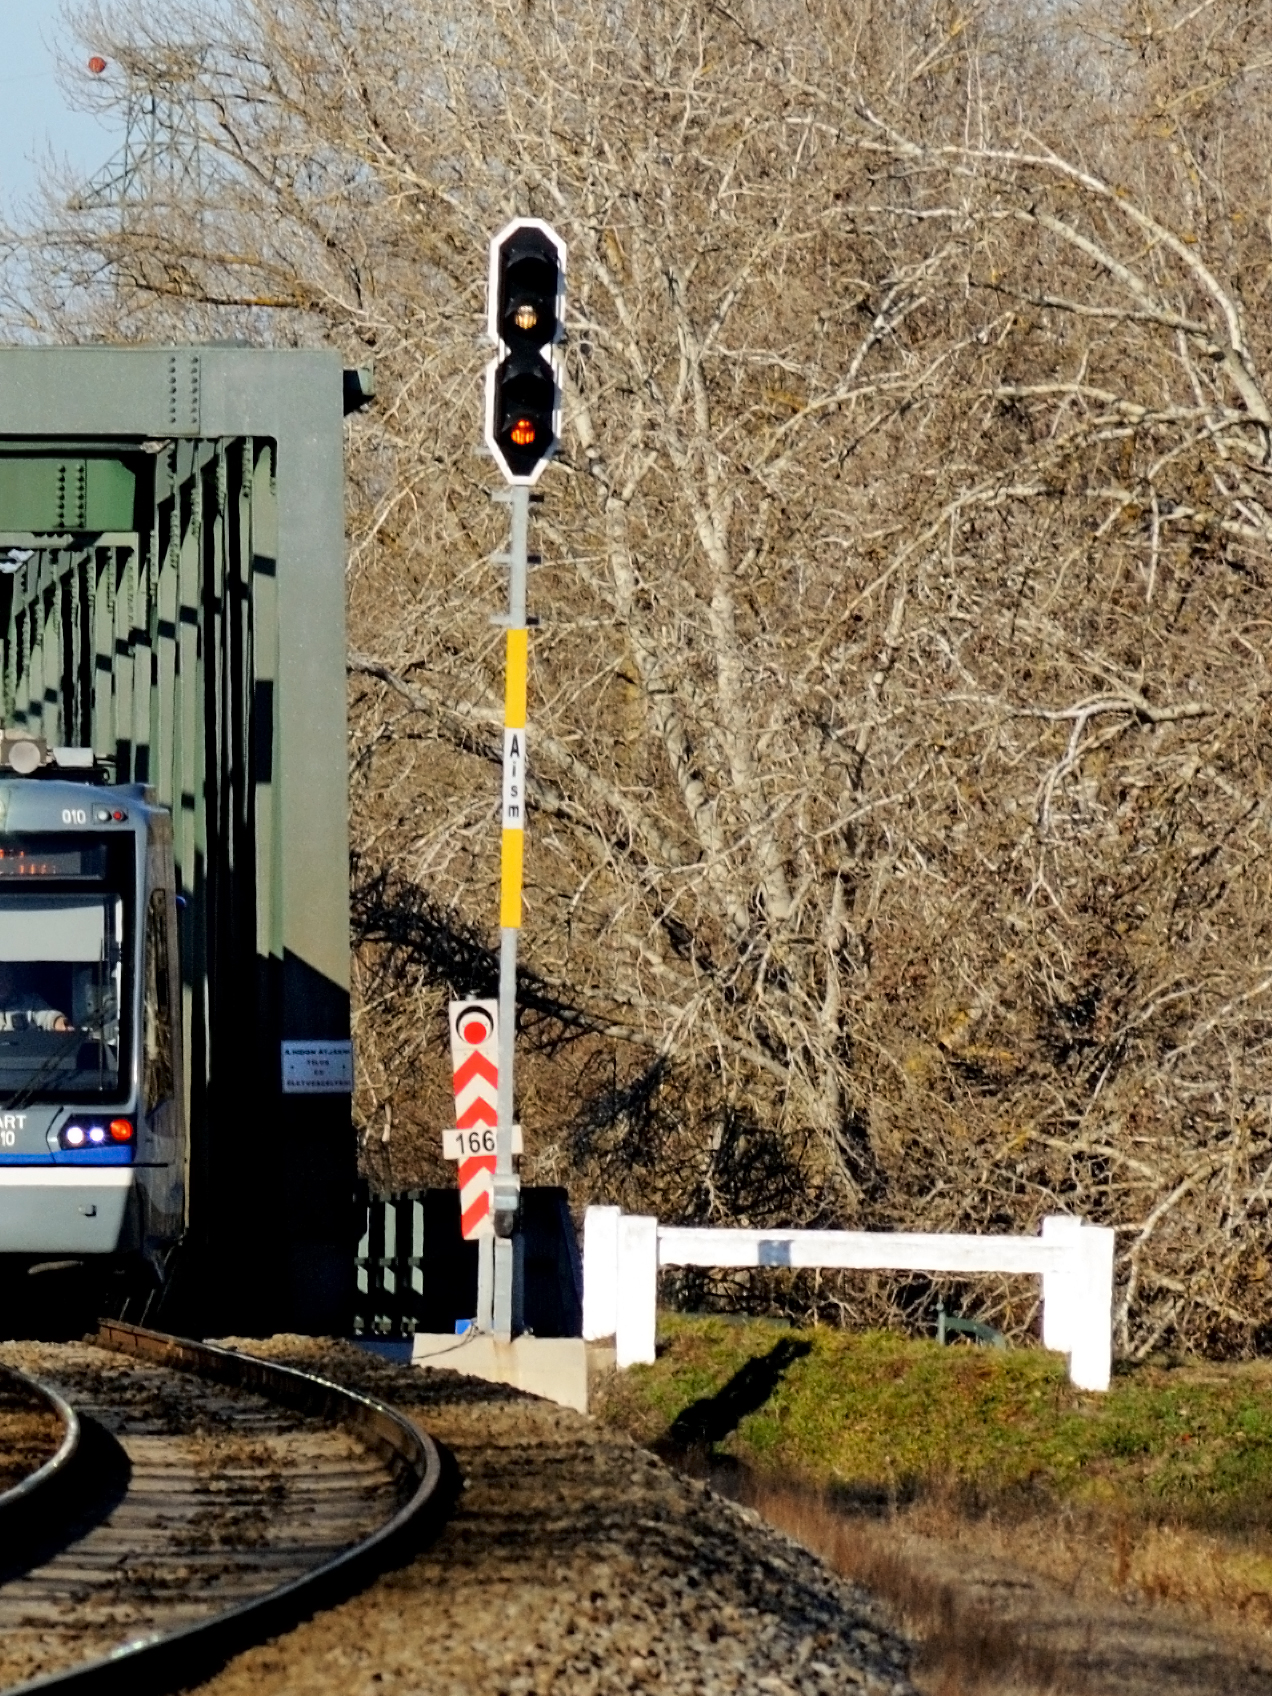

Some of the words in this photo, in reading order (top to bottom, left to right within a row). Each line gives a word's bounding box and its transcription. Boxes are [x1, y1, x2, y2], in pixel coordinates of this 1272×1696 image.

[508, 733, 520, 818] Aism
[61, 808, 87, 825] 010
[455, 1130, 495, 1155] 166
